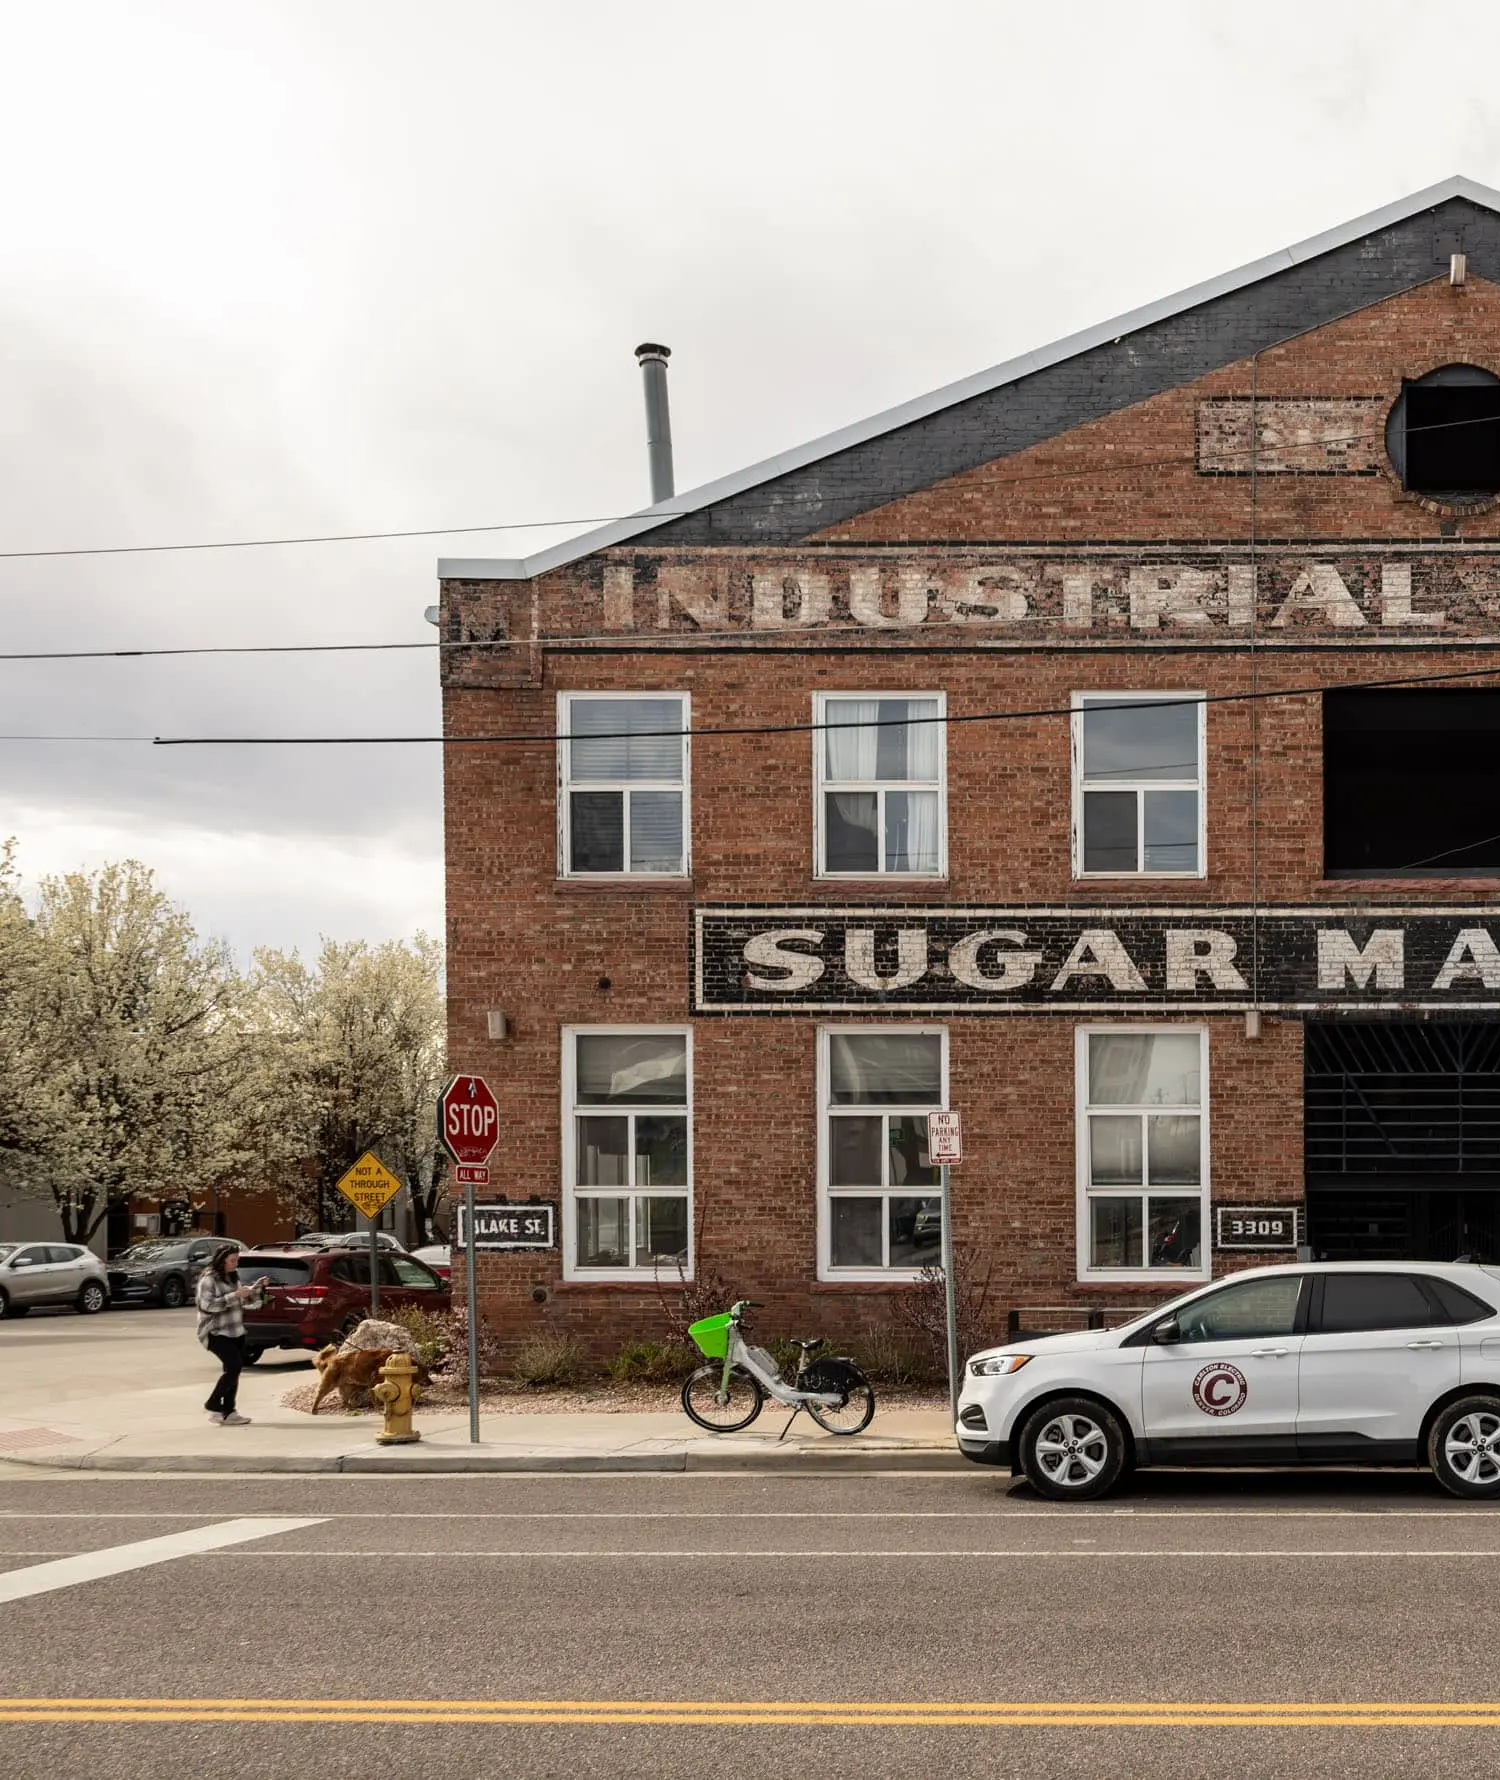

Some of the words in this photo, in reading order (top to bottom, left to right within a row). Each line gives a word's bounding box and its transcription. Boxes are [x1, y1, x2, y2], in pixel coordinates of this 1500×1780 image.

[603, 562, 1446, 629] INDUSTRIAL
[742, 928, 1249, 991] SUGAR
[448, 1103, 495, 1136] STOP
[938, 1115, 950, 1124] NO
[931, 1127, 959, 1136] PARKING
[355, 1167, 372, 1176] NOT
[376, 1167, 383, 1175] A
[460, 1169, 471, 1180] ALL
[474, 1170, 486, 1180] WAY
[350, 1180, 390, 1189] THROUGH
[354, 1192, 385, 1201] STREET
[524, 1219, 545, 1235] ST.
[1232, 1220, 1283, 1235] 3309
[1204, 1373, 1235, 1406] C
